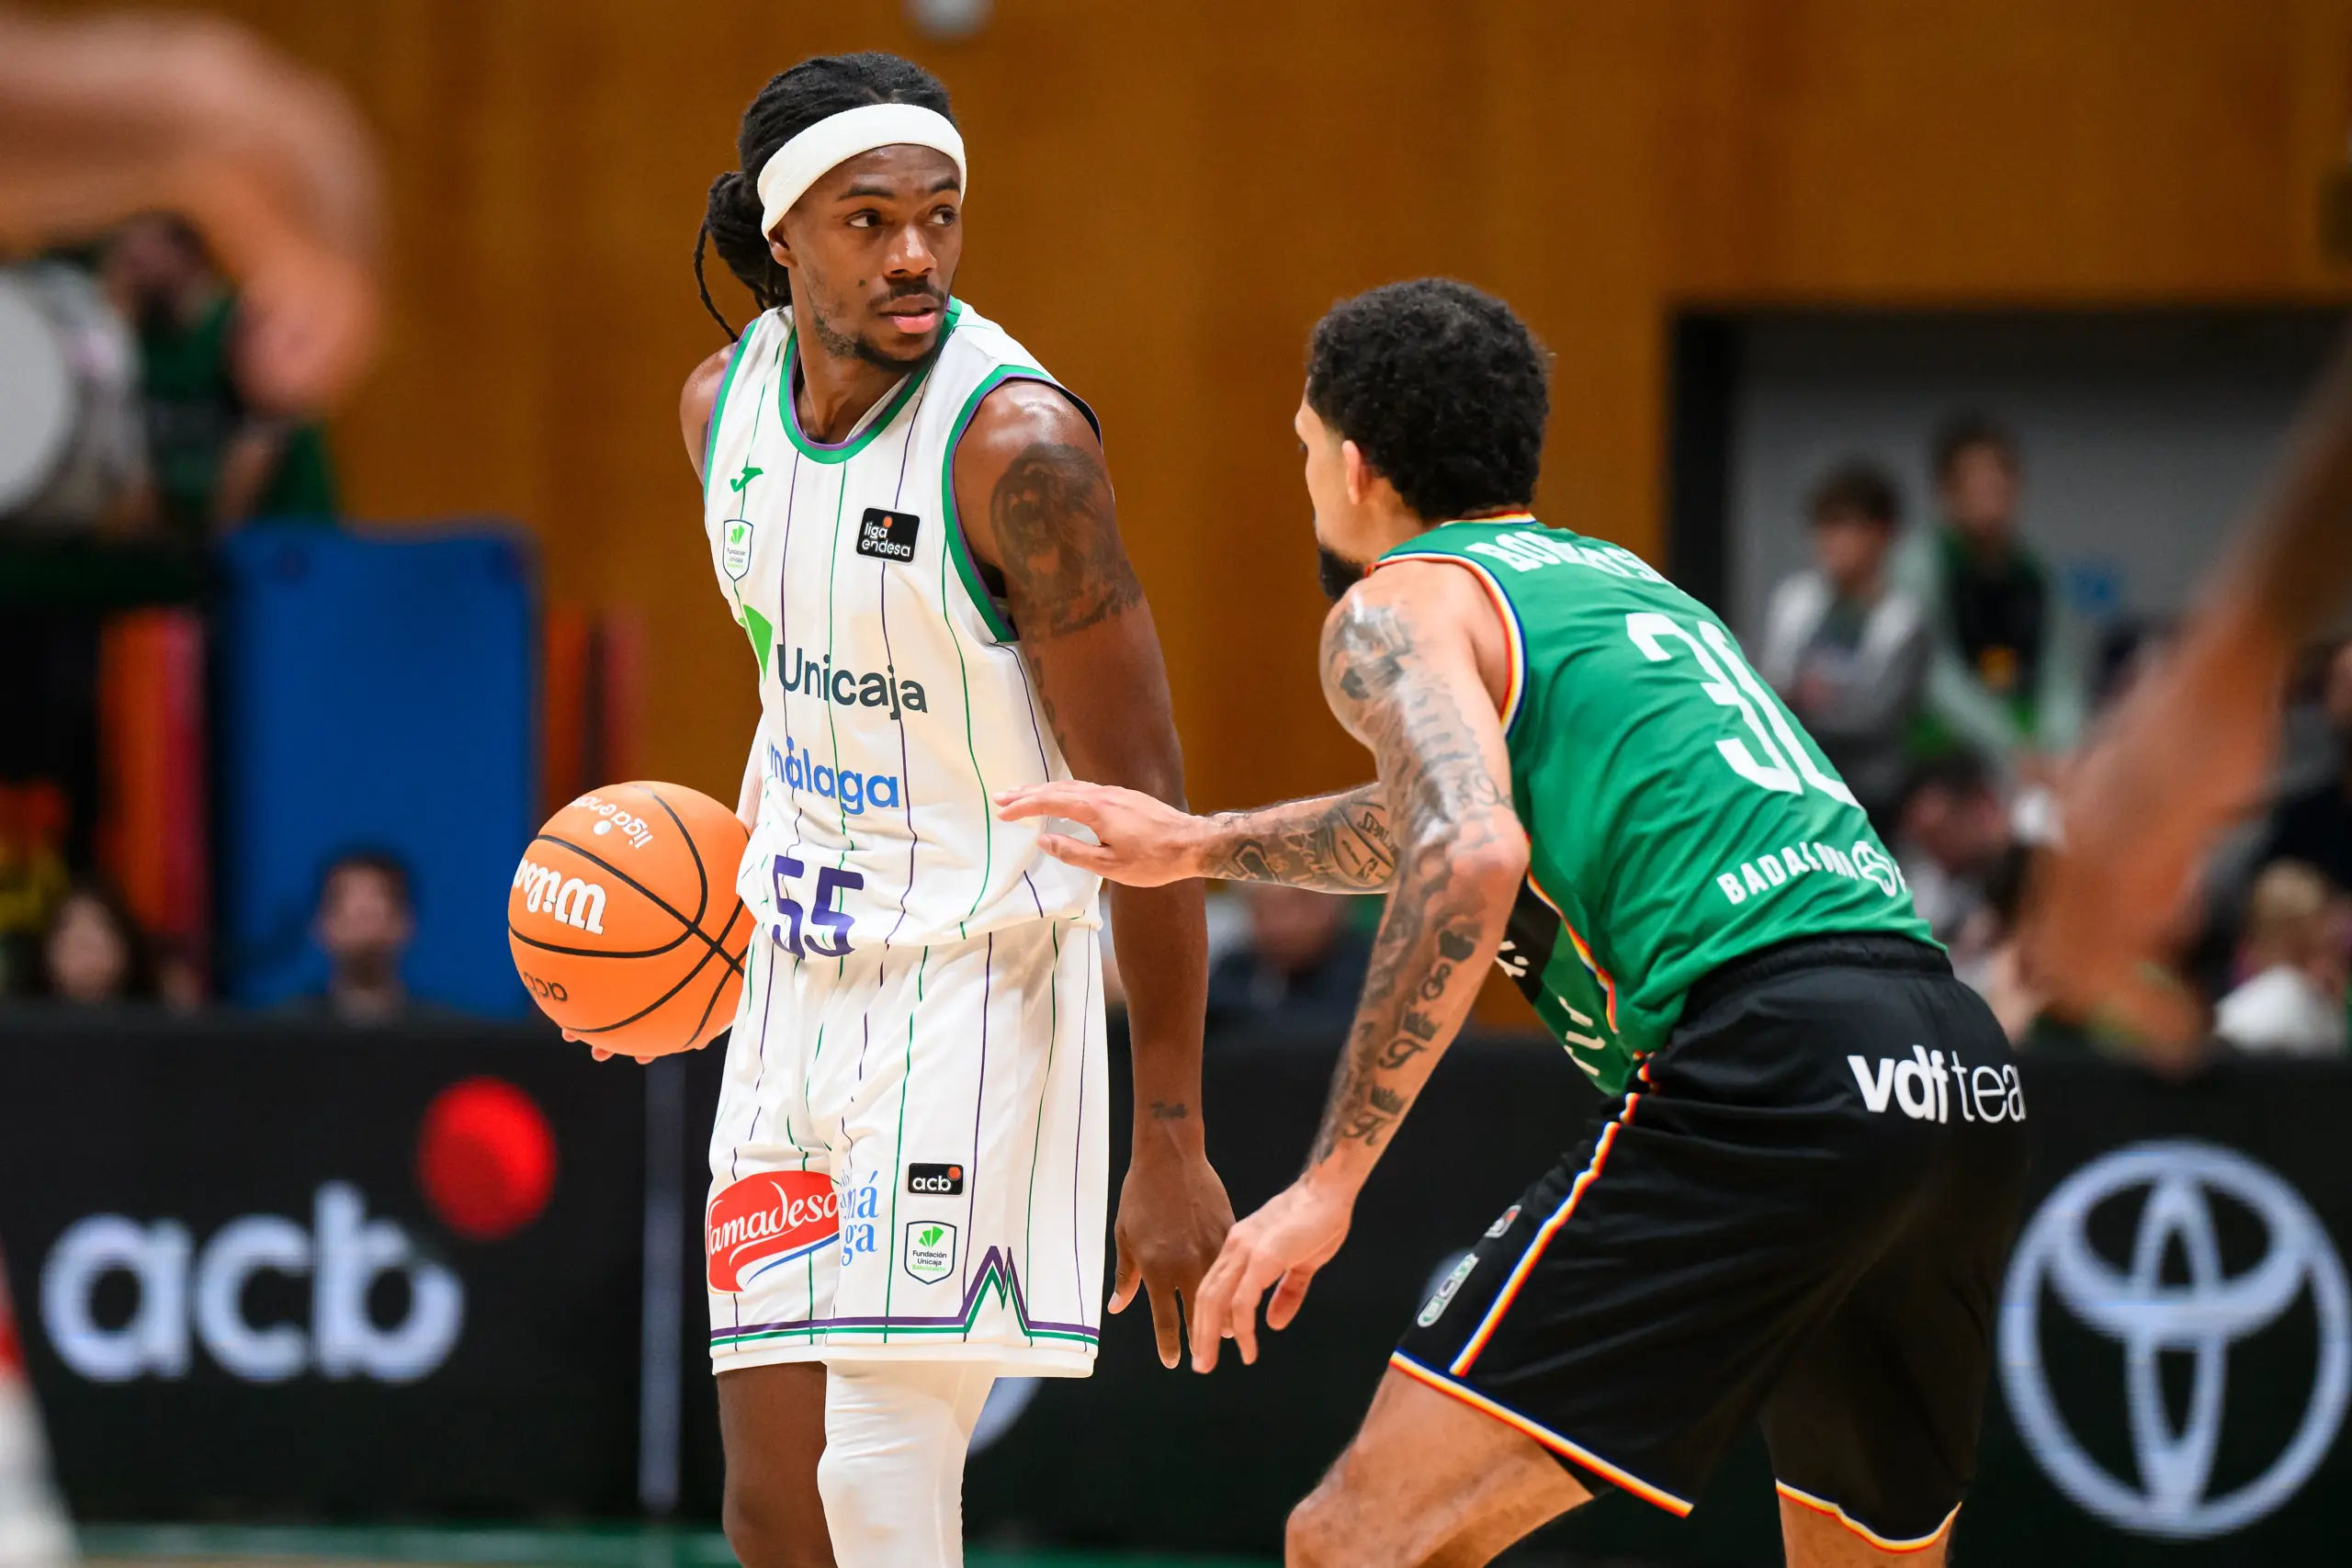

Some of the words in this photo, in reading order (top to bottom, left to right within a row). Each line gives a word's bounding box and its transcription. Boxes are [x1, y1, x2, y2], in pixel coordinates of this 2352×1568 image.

[862, 538, 911, 557] endesa
[864, 521, 888, 539] liga
[777, 644, 928, 720] Unicaja
[611, 811, 653, 849] liga
[513, 858, 606, 935] Wilso
[772, 854, 865, 961] 55
[1847, 1044, 1950, 1123] vdf
[1951, 1051, 2027, 1123] tea
[912, 1175, 952, 1191] acb
[39, 1179, 465, 1383] acb
[917, 1258, 943, 1267] Unicaja
